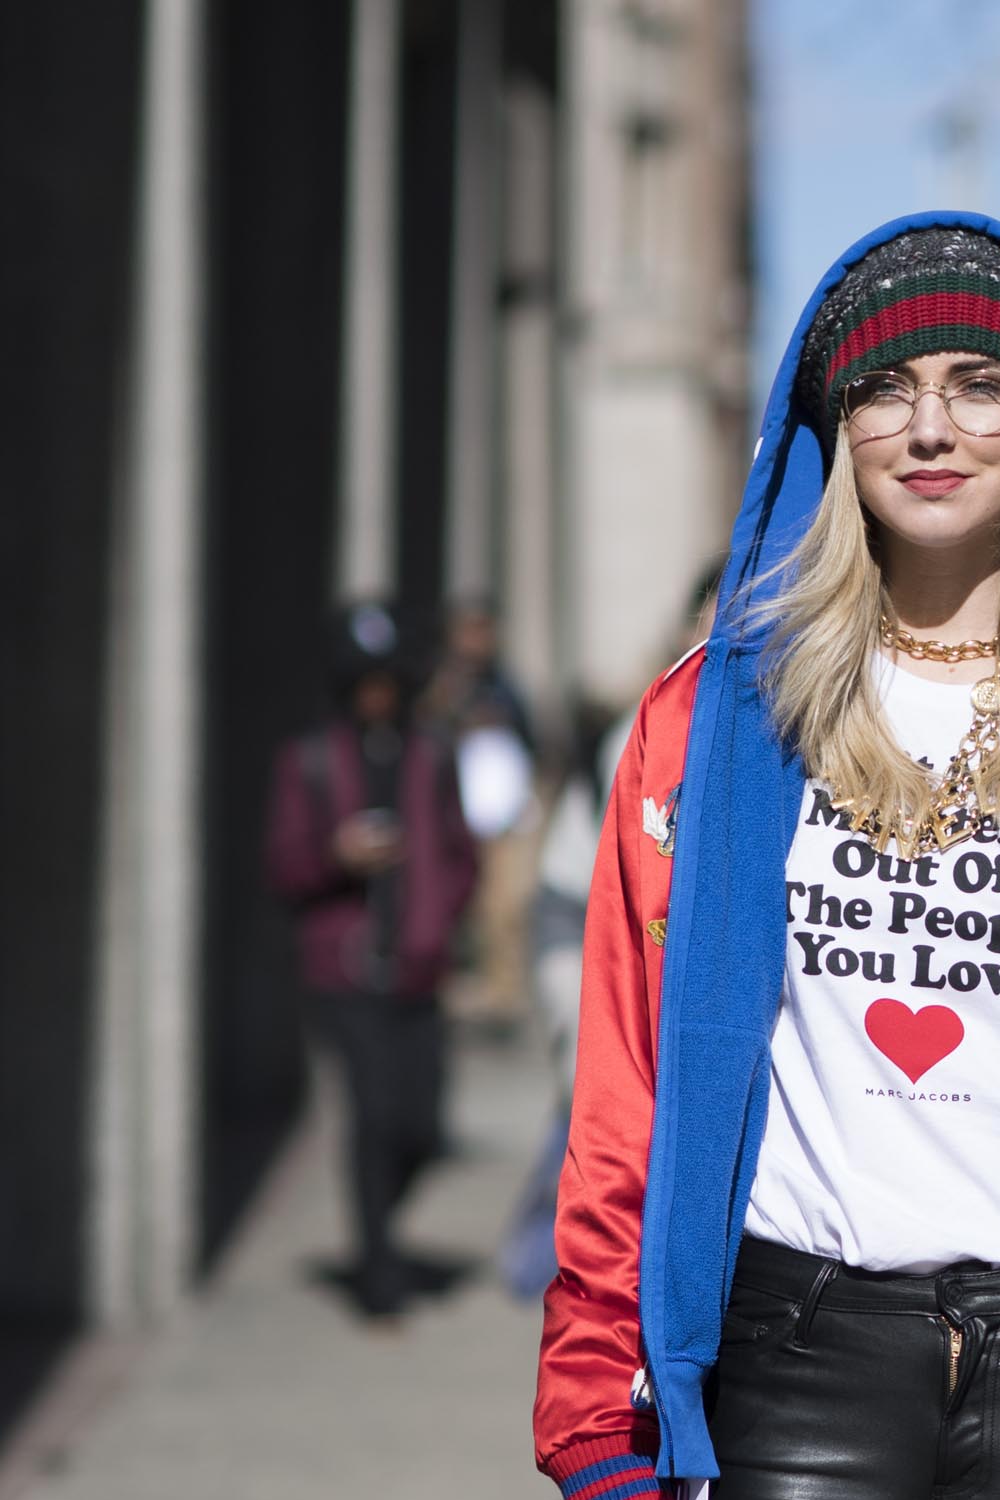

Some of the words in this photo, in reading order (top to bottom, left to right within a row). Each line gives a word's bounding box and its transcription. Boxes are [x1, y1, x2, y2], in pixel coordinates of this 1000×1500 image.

[832, 839, 939, 887] Out
[793, 931, 896, 984] You
[865, 1088, 903, 1099] MARC
[908, 1092, 972, 1102] JACOBS
